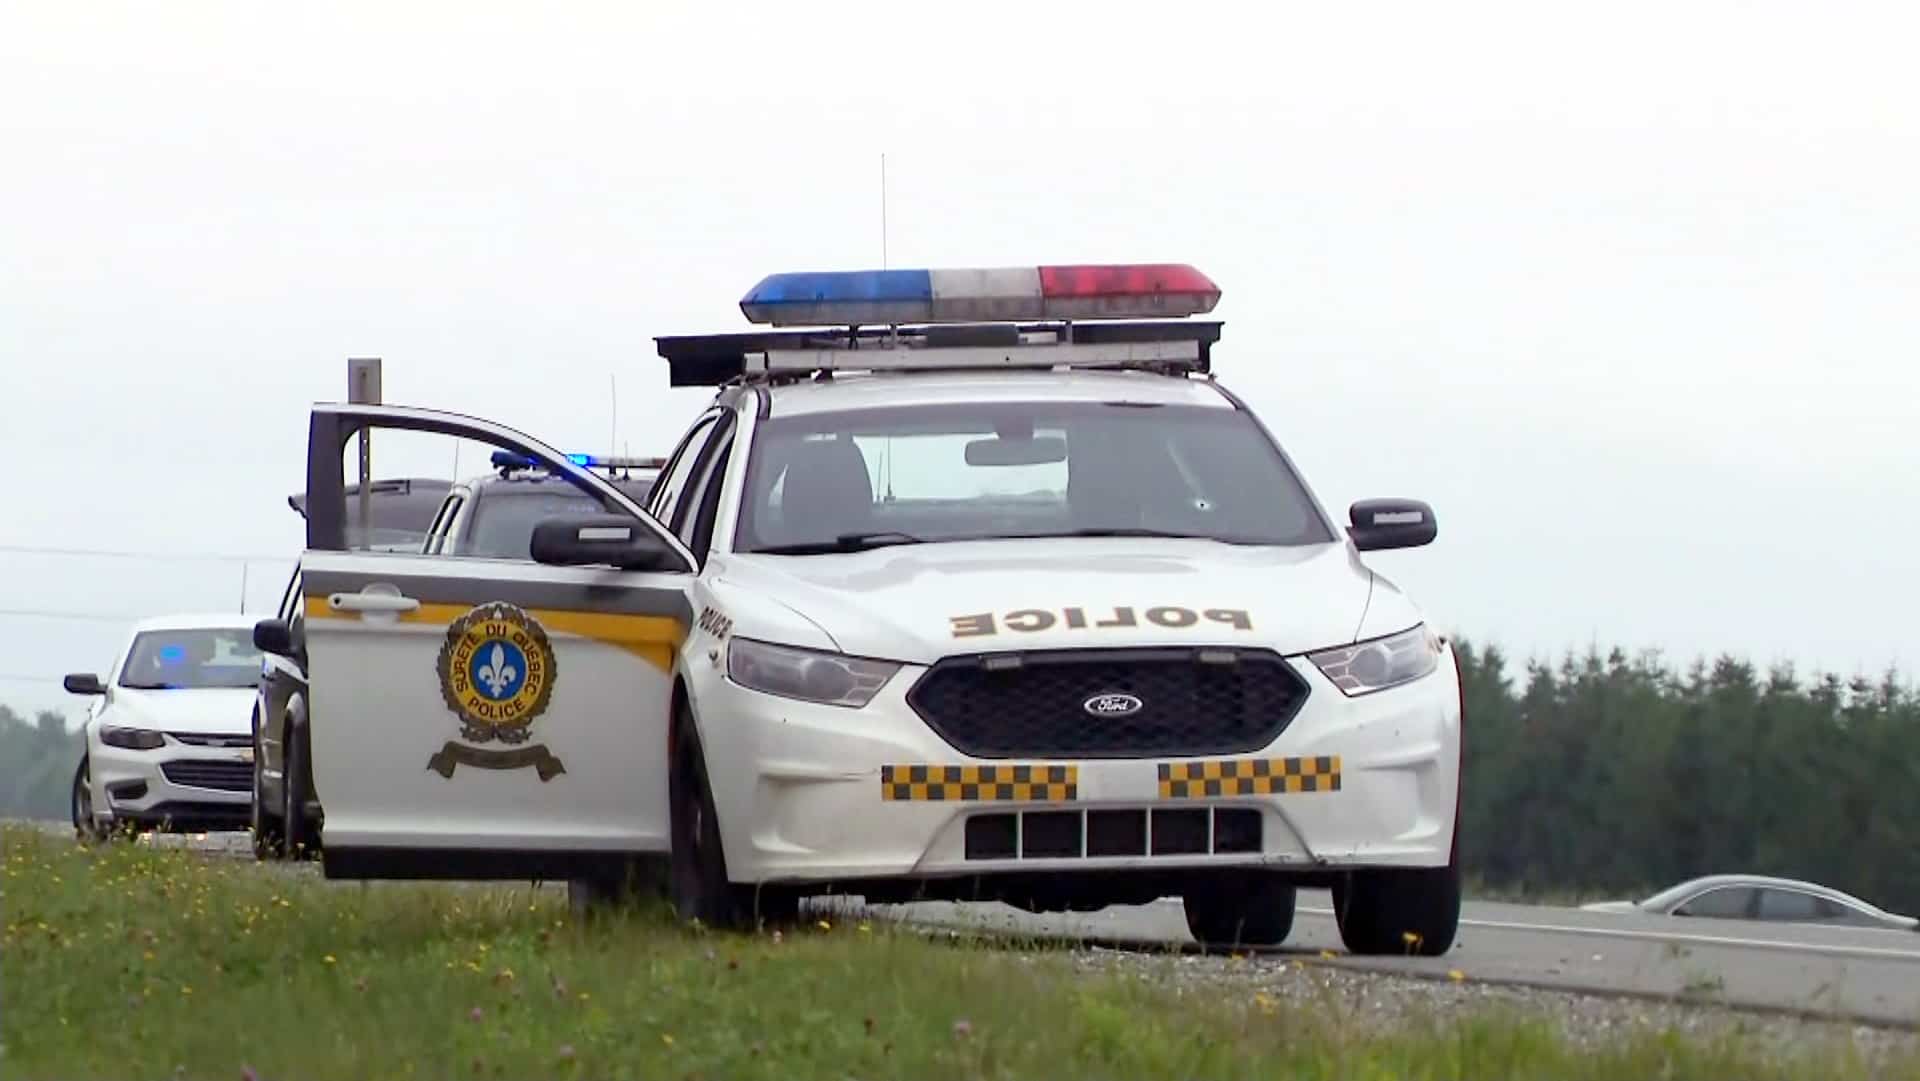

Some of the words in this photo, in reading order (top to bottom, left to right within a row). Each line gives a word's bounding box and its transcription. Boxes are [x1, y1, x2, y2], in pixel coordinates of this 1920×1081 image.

[486, 624, 507, 637] DU
[699, 605, 733, 641] POLICE
[468, 697, 526, 719] POLICE
